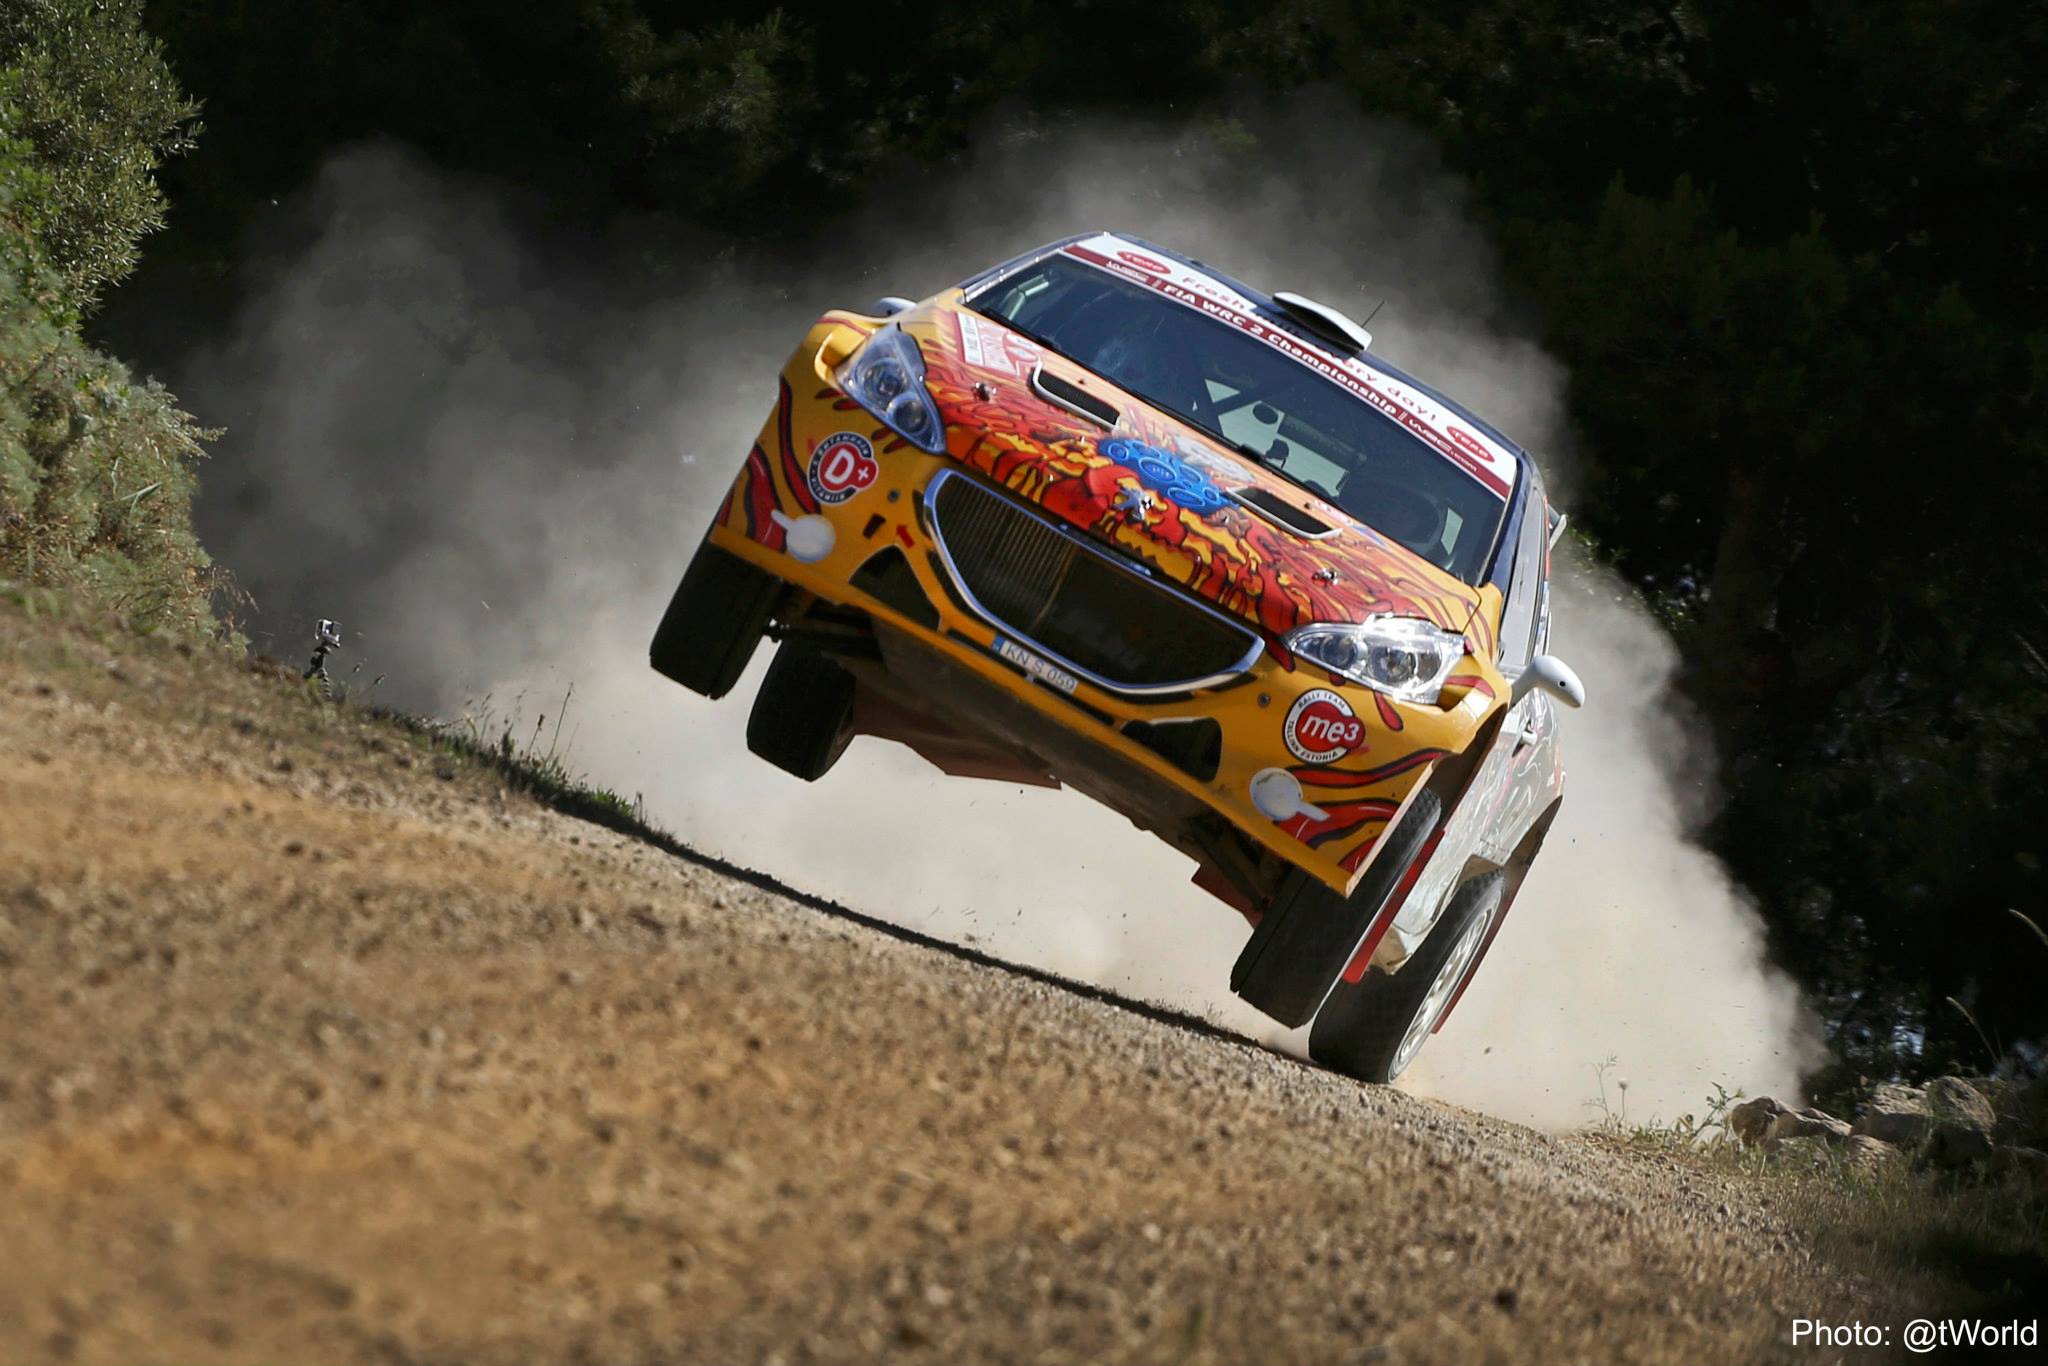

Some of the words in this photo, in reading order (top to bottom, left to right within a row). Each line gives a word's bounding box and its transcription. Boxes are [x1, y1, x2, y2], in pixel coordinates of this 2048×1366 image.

[1182, 277, 1245, 309] Fresh
[1163, 284, 1196, 305] FIA
[1202, 300, 1247, 327] WRC
[1249, 323, 1264, 336] 2
[1268, 334, 1397, 414] Championship
[1298, 691, 1320, 709] RALLY
[1324, 691, 1345, 709] TEAM
[1300, 750, 1338, 762] ESTONIA
